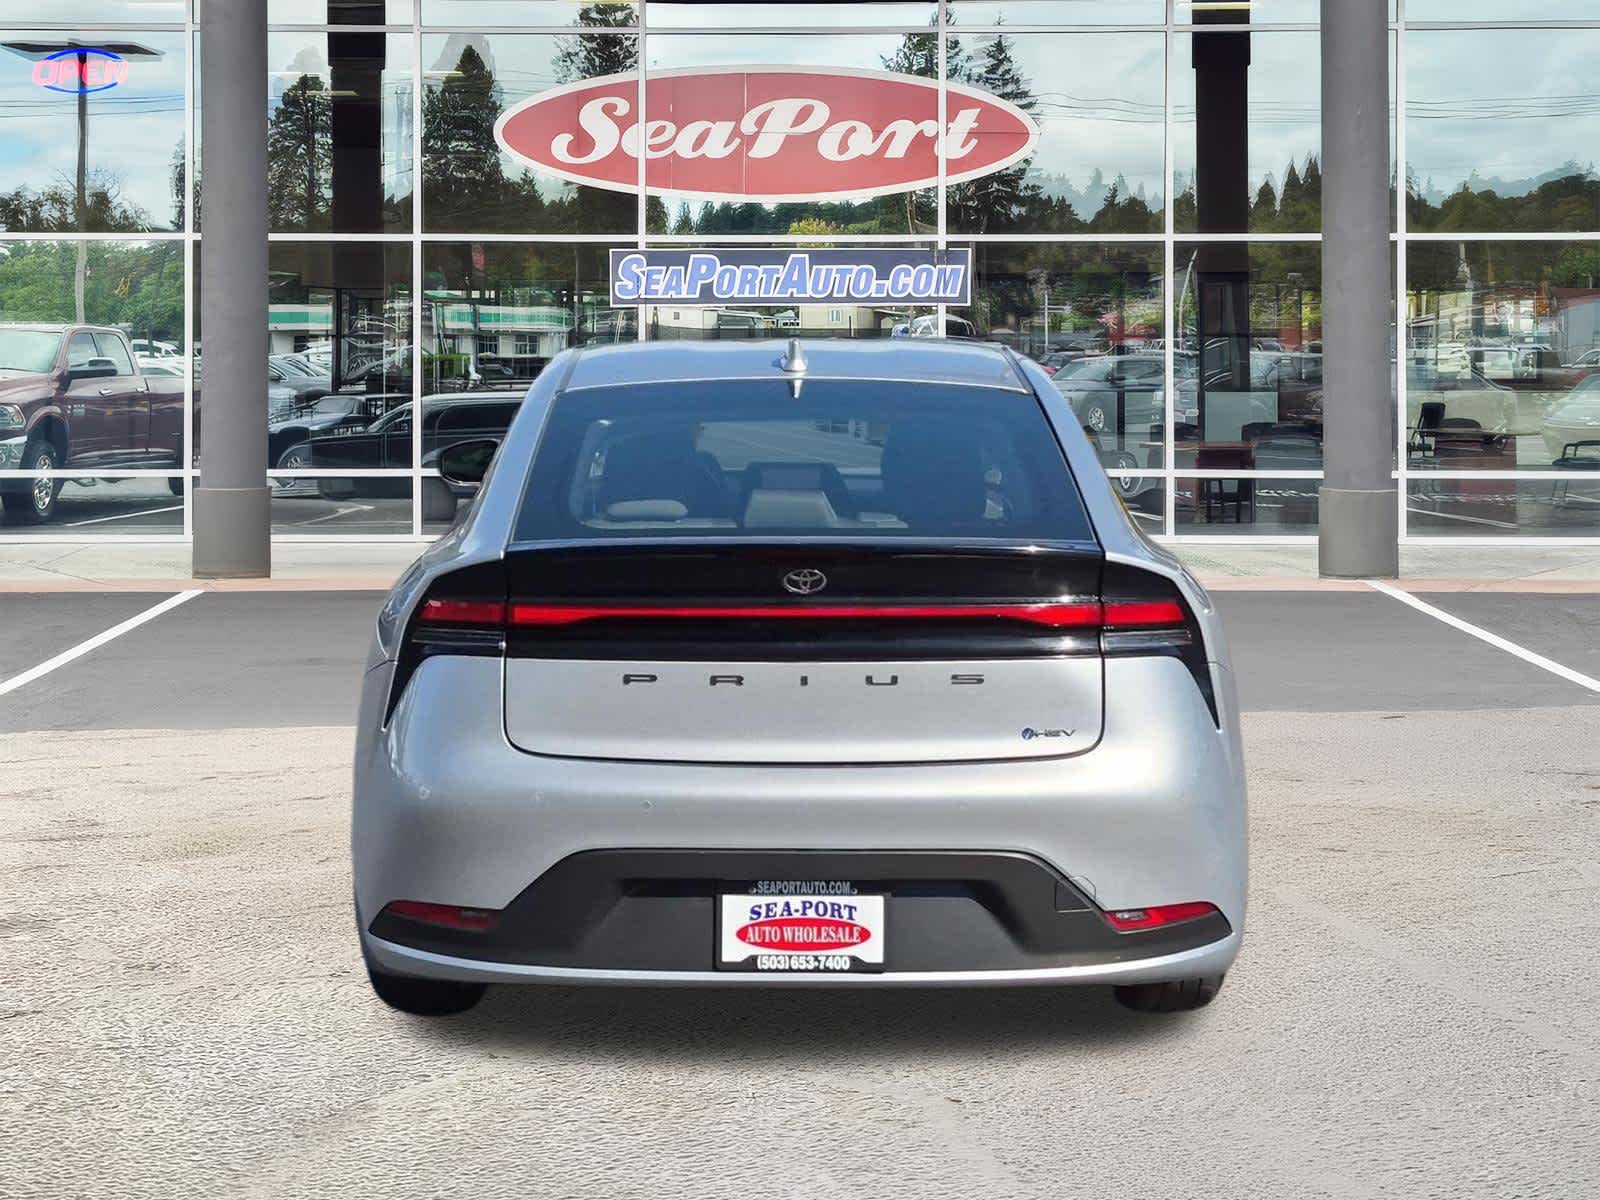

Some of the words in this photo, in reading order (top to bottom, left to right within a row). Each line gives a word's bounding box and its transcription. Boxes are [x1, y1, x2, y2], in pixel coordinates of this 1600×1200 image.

[32, 58, 129, 86] OPEN
[550, 96, 981, 164] SeaPort
[623, 673, 985, 686] PRIUS
[757, 881, 850, 894] SEAPORTAUTO.COM
[750, 900, 857, 920] SEA-PORT
[745, 926, 780, 943] AUTO
[783, 926, 861, 943] WHOLESALE
